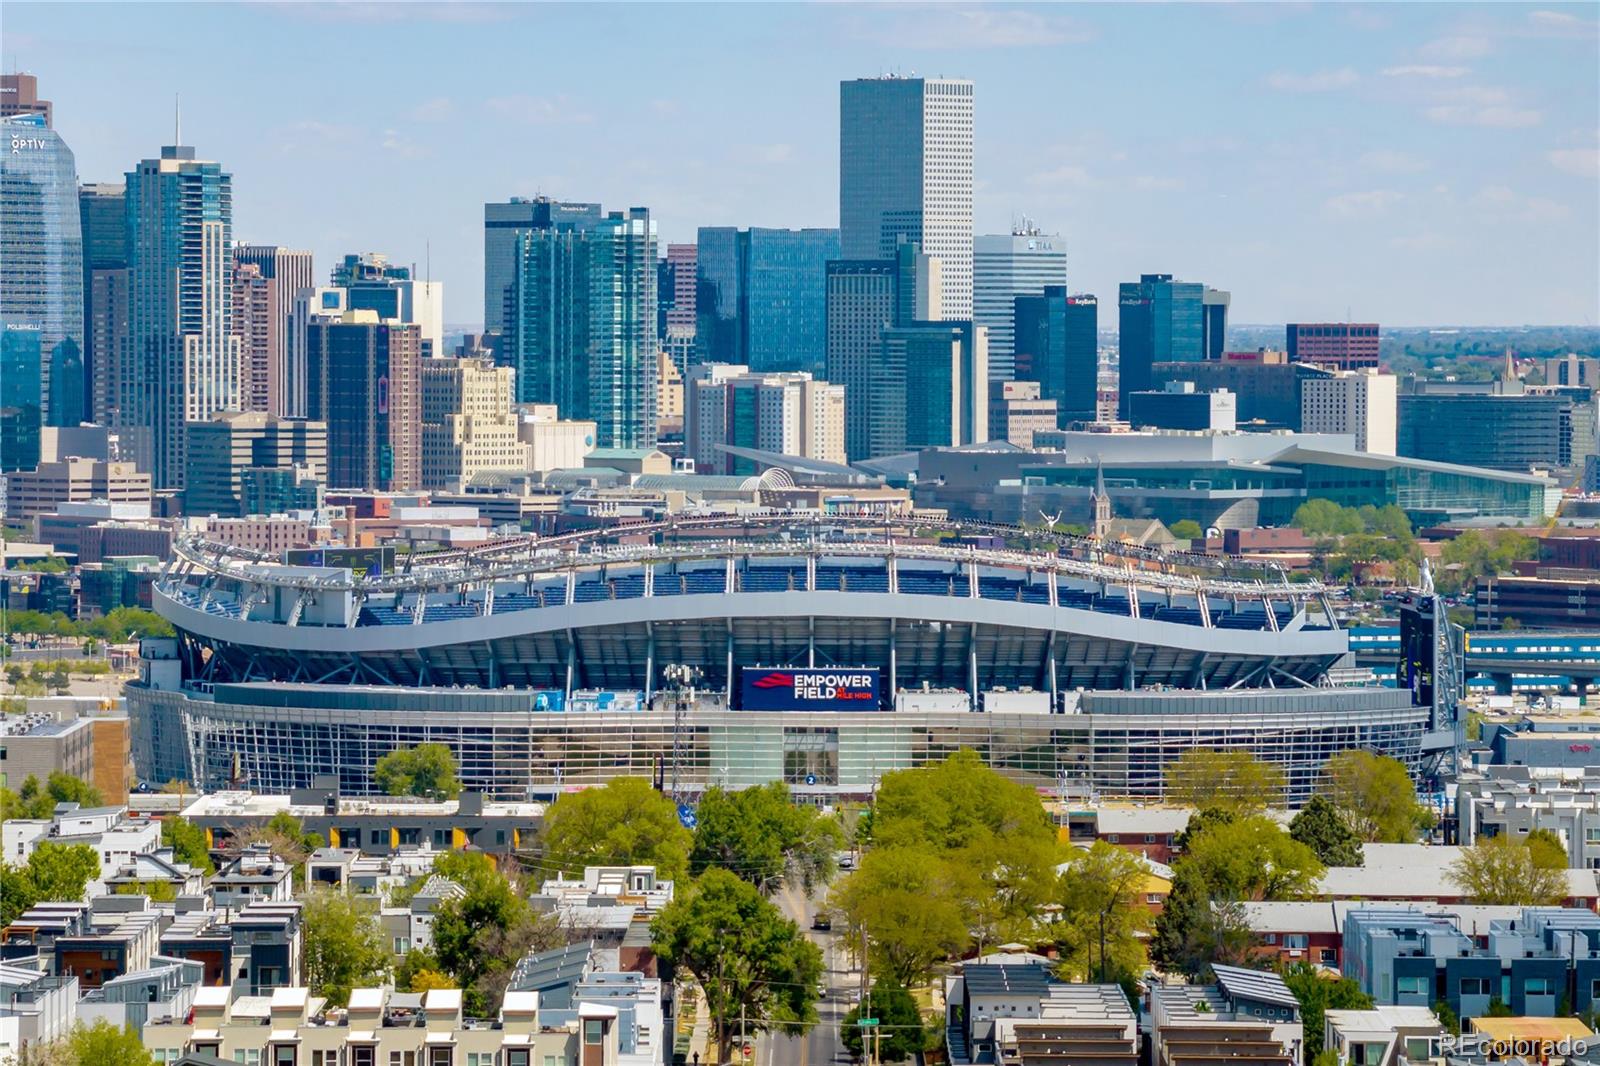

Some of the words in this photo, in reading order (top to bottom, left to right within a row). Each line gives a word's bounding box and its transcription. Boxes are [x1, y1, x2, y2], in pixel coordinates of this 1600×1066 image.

[11, 136, 45, 152] OPTIV
[1035, 241, 1053, 250] TIAA
[1075, 298, 1097, 307] KeyBank
[794, 675, 872, 687] EMPOWER
[794, 687, 836, 699] FIELD
